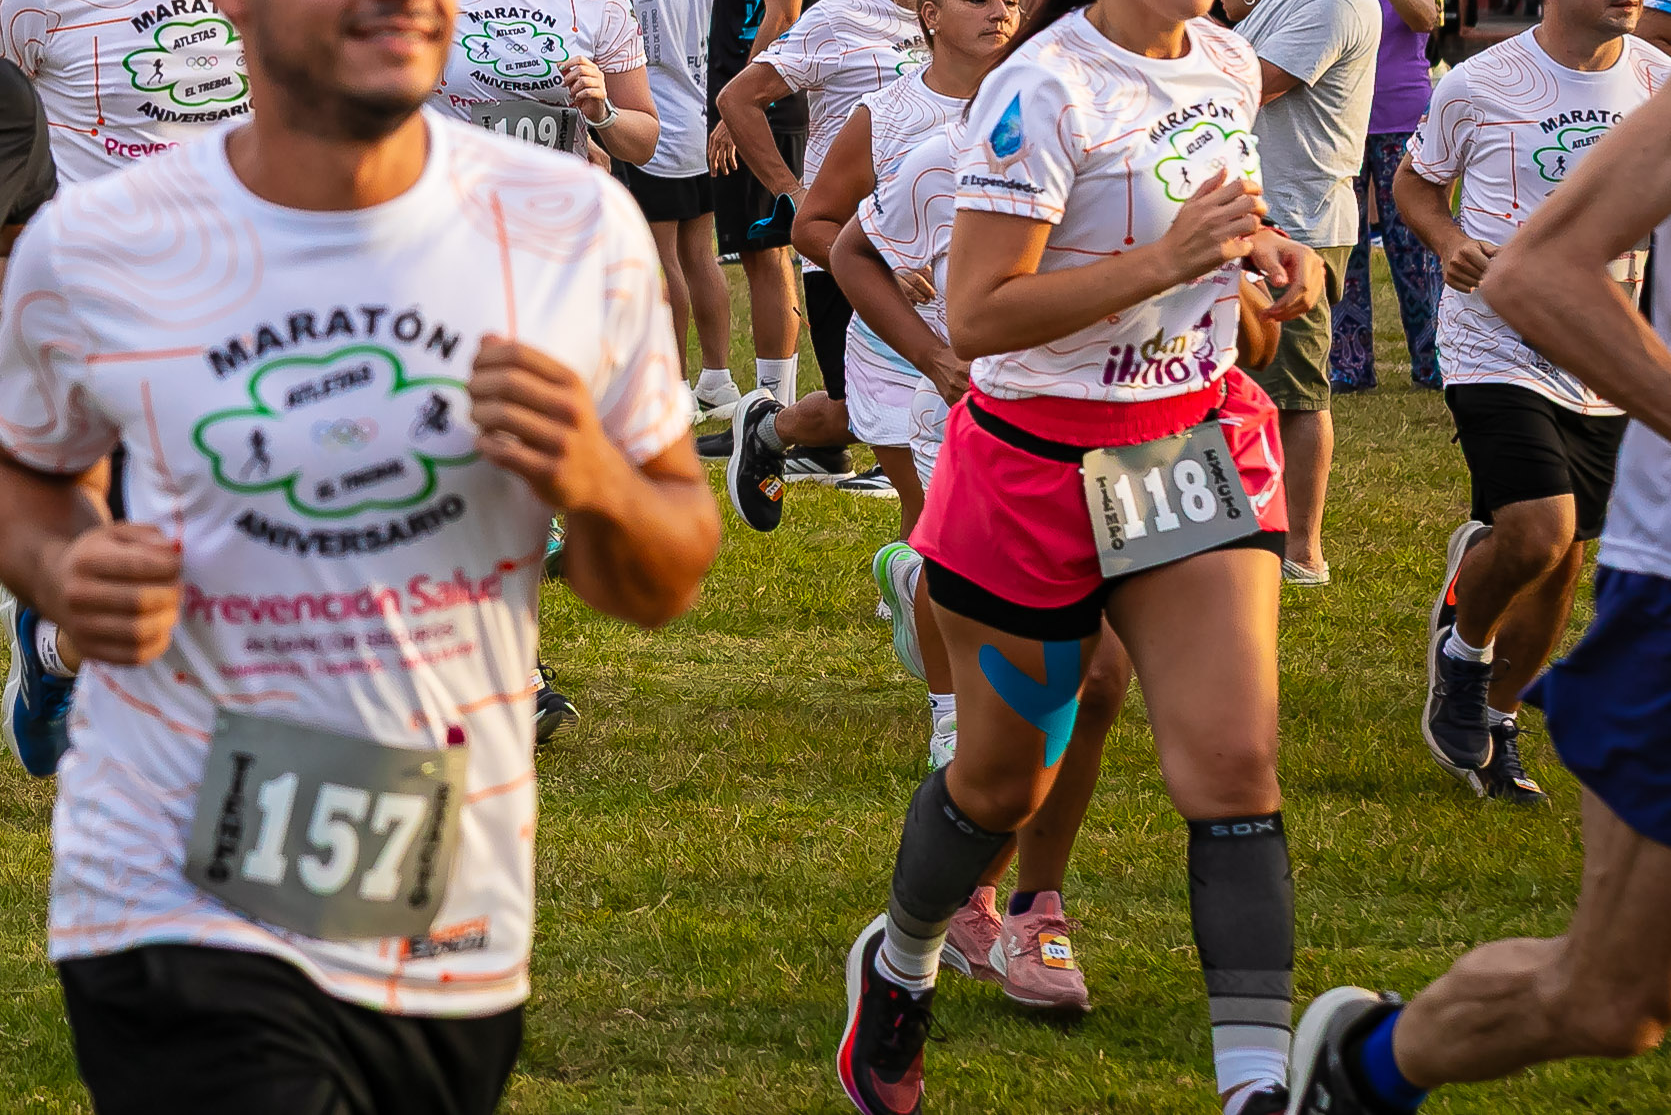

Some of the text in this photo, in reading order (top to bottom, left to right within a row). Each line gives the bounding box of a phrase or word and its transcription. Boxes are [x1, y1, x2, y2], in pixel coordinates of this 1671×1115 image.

[467, 6, 557, 28] MARATÓN
[173, 28, 217, 50] ATLETAS
[496, 26, 527, 37] ATLETAS
[515, 59, 541, 70] TREBOL
[184, 76, 233, 98] EL TREBOL
[470, 70, 563, 91] ANIVERSARIO
[494, 116, 558, 149] 109
[1149, 98, 1235, 144] MARATÓN
[1539, 109, 1625, 135] MARATÓ
[207, 302, 462, 381] MARATÓN
[1204, 448, 1241, 520] EXACTO
[1096, 475, 1124, 550] TIEMPO
[1113, 459, 1218, 540] 118
[241, 772, 428, 902] 157
[1210, 818, 1275, 836] SOX
